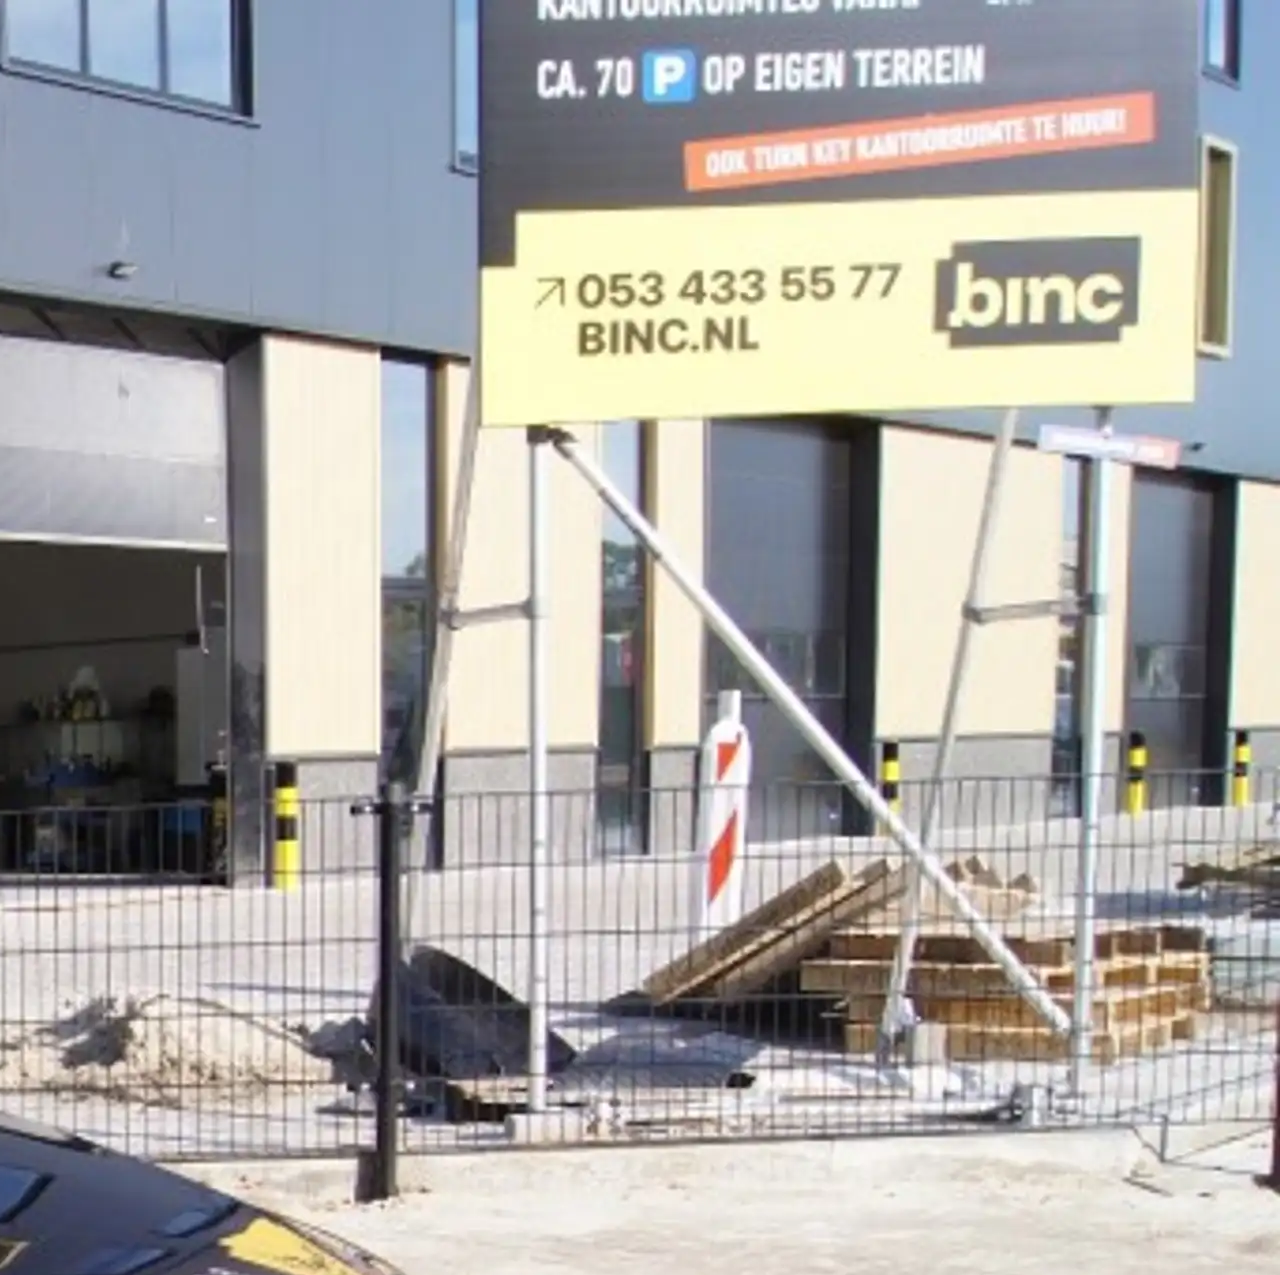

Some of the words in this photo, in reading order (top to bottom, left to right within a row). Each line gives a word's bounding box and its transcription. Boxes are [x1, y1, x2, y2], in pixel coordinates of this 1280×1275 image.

[537, 59, 587, 99] CA.
[596, 56, 634, 97] 70
[652, 55, 687, 96] P
[703, 54, 746, 95] OP
[754, 50, 845, 92] EIGEN
[853, 44, 986, 88] TERREIN
[705, 149, 749, 178] OOK
[752, 141, 809, 171] TURN
[811, 137, 852, 166] KEY
[1031, 113, 1057, 141] TE
[576, 270, 666, 309] 053
[677, 267, 767, 306] 433
[780, 264, 837, 302] 55
[849, 262, 903, 300] 77
[577, 315, 761, 357] BINC.NL
